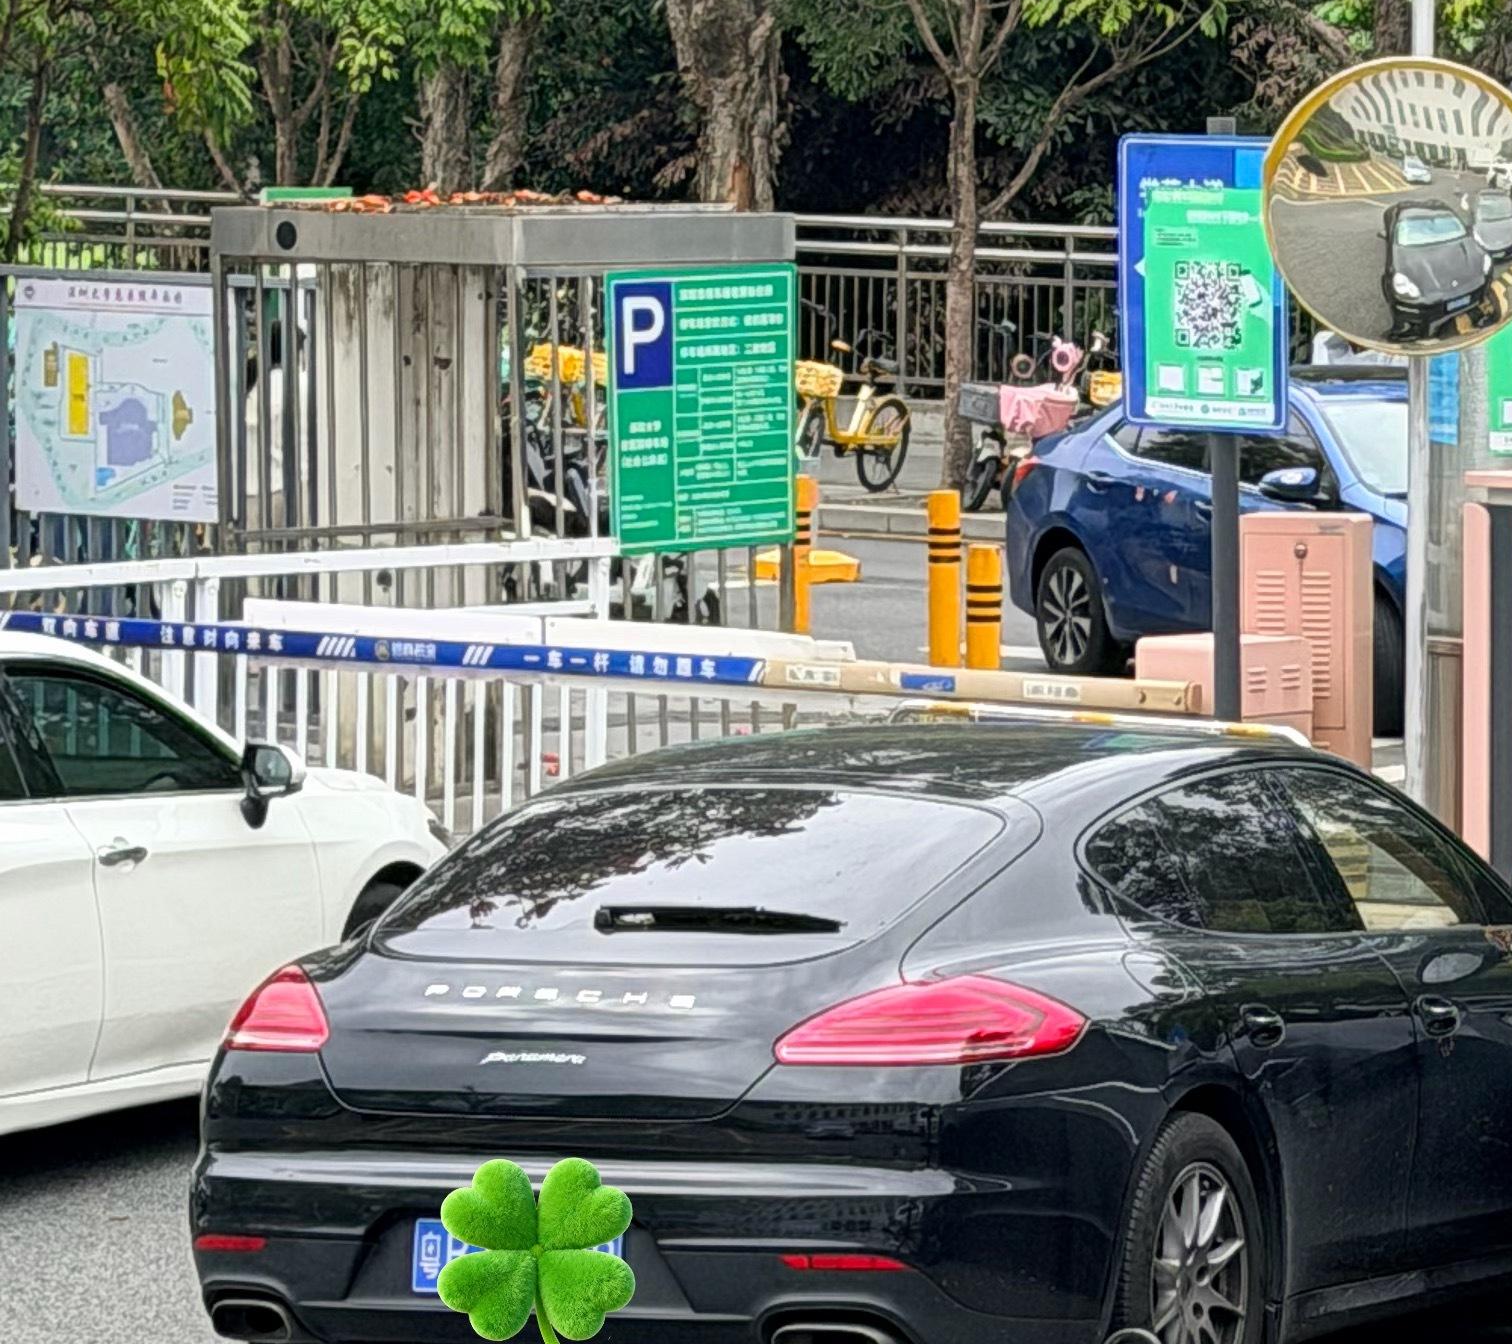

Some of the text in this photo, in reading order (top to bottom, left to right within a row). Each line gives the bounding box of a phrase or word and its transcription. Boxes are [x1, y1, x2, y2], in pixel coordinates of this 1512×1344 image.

[621, 295, 665, 375] P
[523, 649, 609, 674] 一车一杆
[424, 983, 696, 1009] PORSCHE
